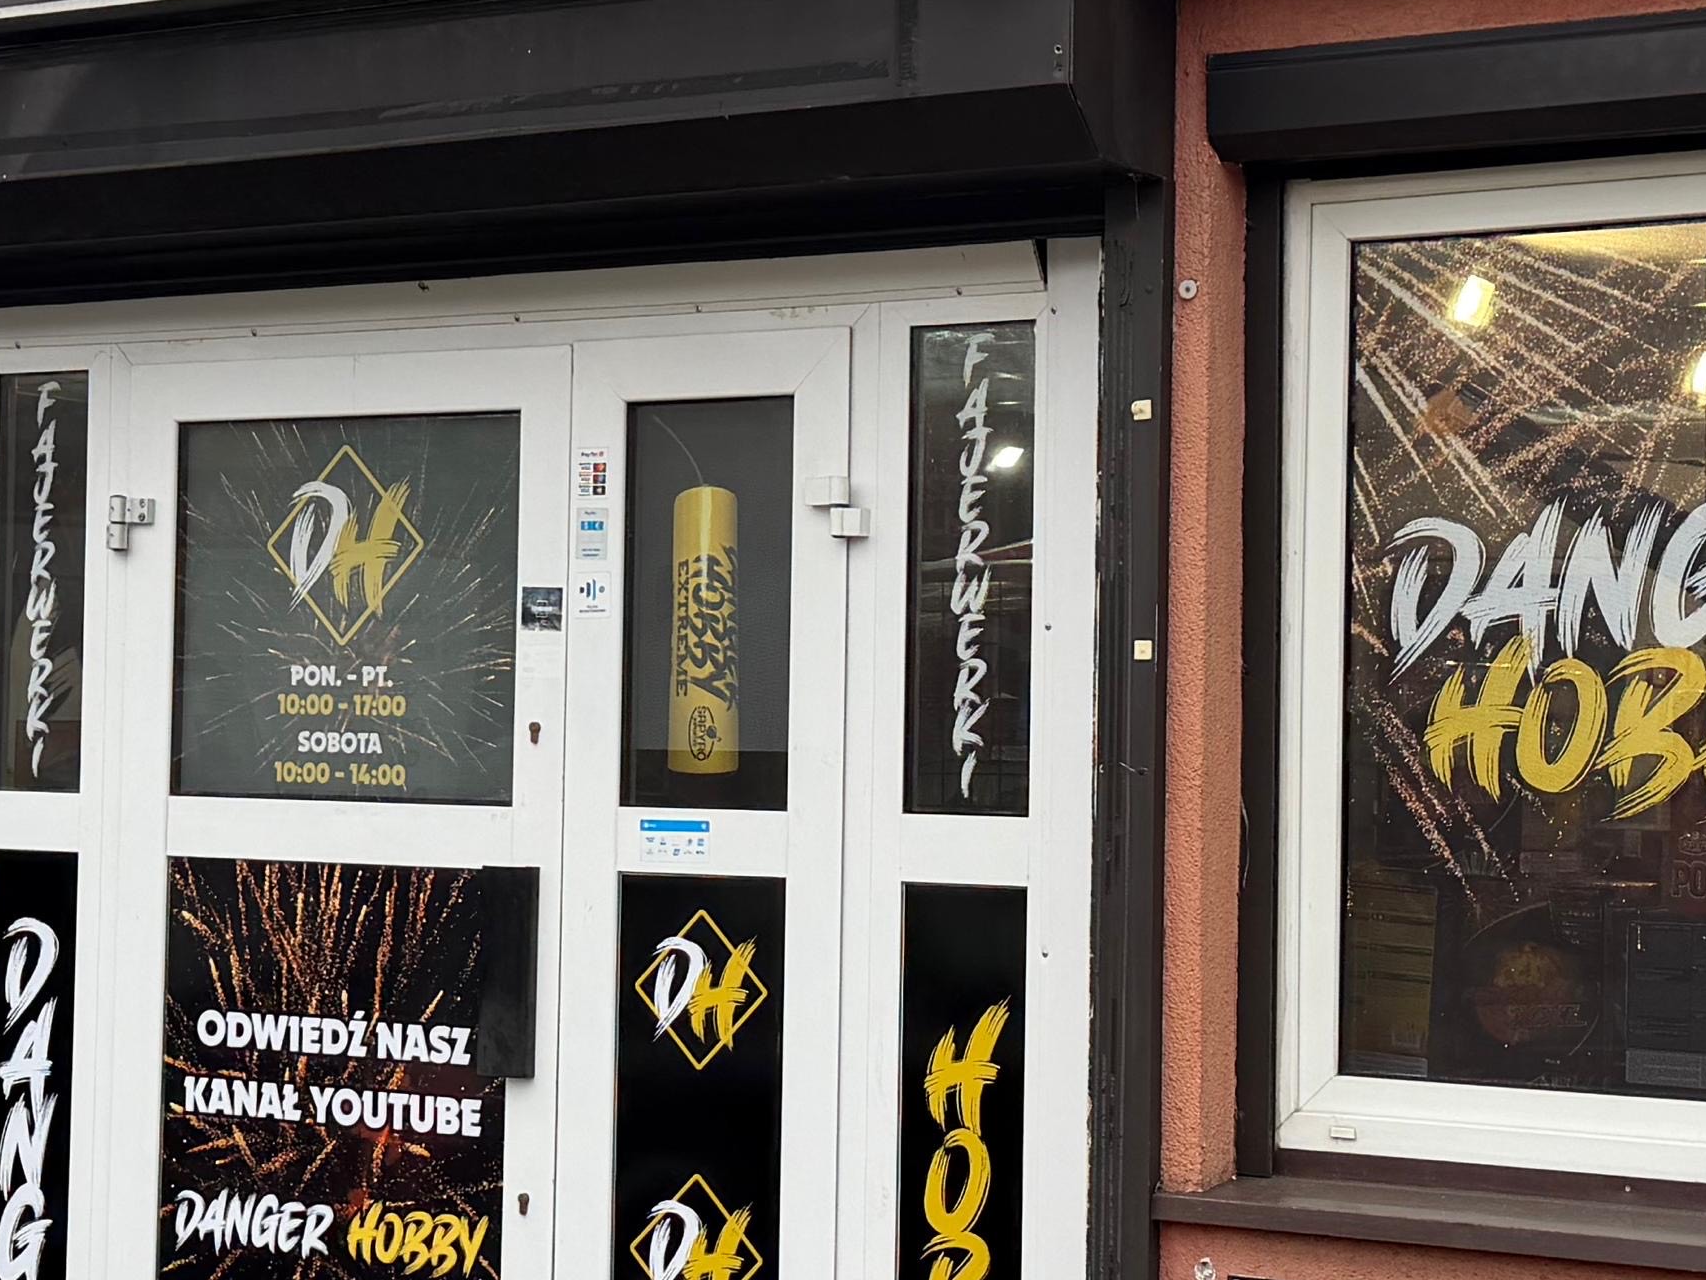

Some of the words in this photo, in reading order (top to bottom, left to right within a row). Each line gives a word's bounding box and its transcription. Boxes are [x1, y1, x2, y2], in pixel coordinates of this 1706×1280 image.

[26, 381, 62, 778] FAJERWERKI
[949, 333, 993, 799] FAJERWERKI
[676, 558, 690, 698] EXTREME
[277, 694, 332, 716] 10:00
[354, 695, 407, 717] 17:00
[290, 665, 341, 688] PON.
[361, 665, 393, 688] PT.
[297, 731, 383, 756] SOBOTA
[273, 761, 330, 786] 10:00
[349, 762, 407, 787] 14:00
[197, 1010, 367, 1056] ODWIEDŹ
[377, 1024, 471, 1065] NASZ
[184, 1076, 301, 1121] KANAŁ
[309, 1085, 482, 1138] YOUTUBE
[174, 1189, 334, 1258] DANGER
[347, 1212, 489, 1278] HOBBY
